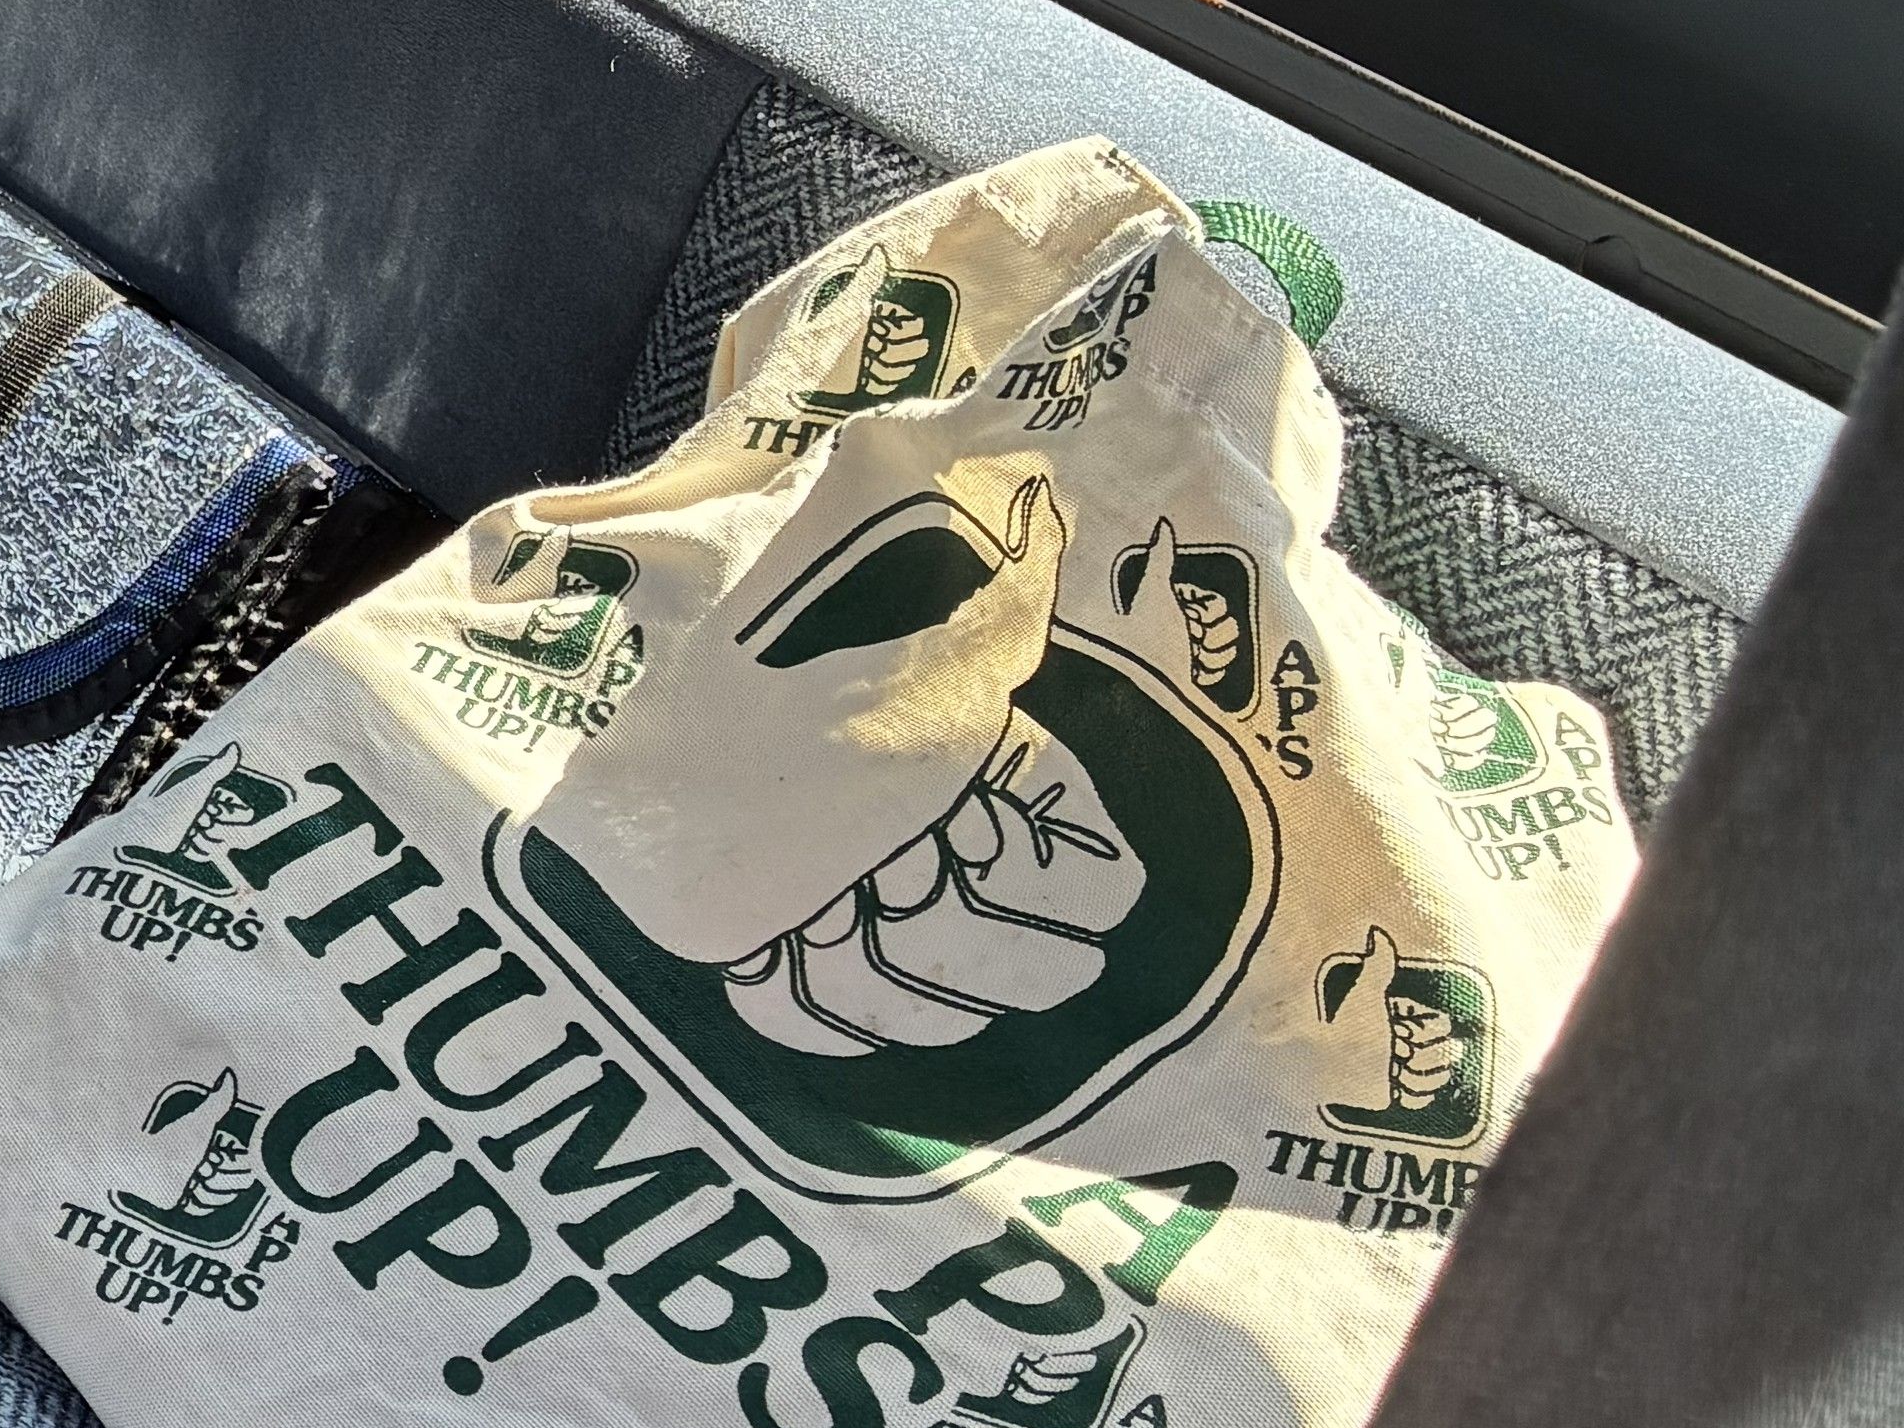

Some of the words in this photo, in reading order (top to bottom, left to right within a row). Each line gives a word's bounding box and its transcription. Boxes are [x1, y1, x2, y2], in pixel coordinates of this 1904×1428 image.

[410, 641, 617, 738] THUMBS
[455, 697, 547, 753] UP!
[64, 865, 265, 952] THUMBS
[100, 905, 192, 963] UP!
[54, 1201, 266, 1312] THUMBS
[259, 1044, 601, 1397] UP!
[95, 1261, 190, 1326] UP!
